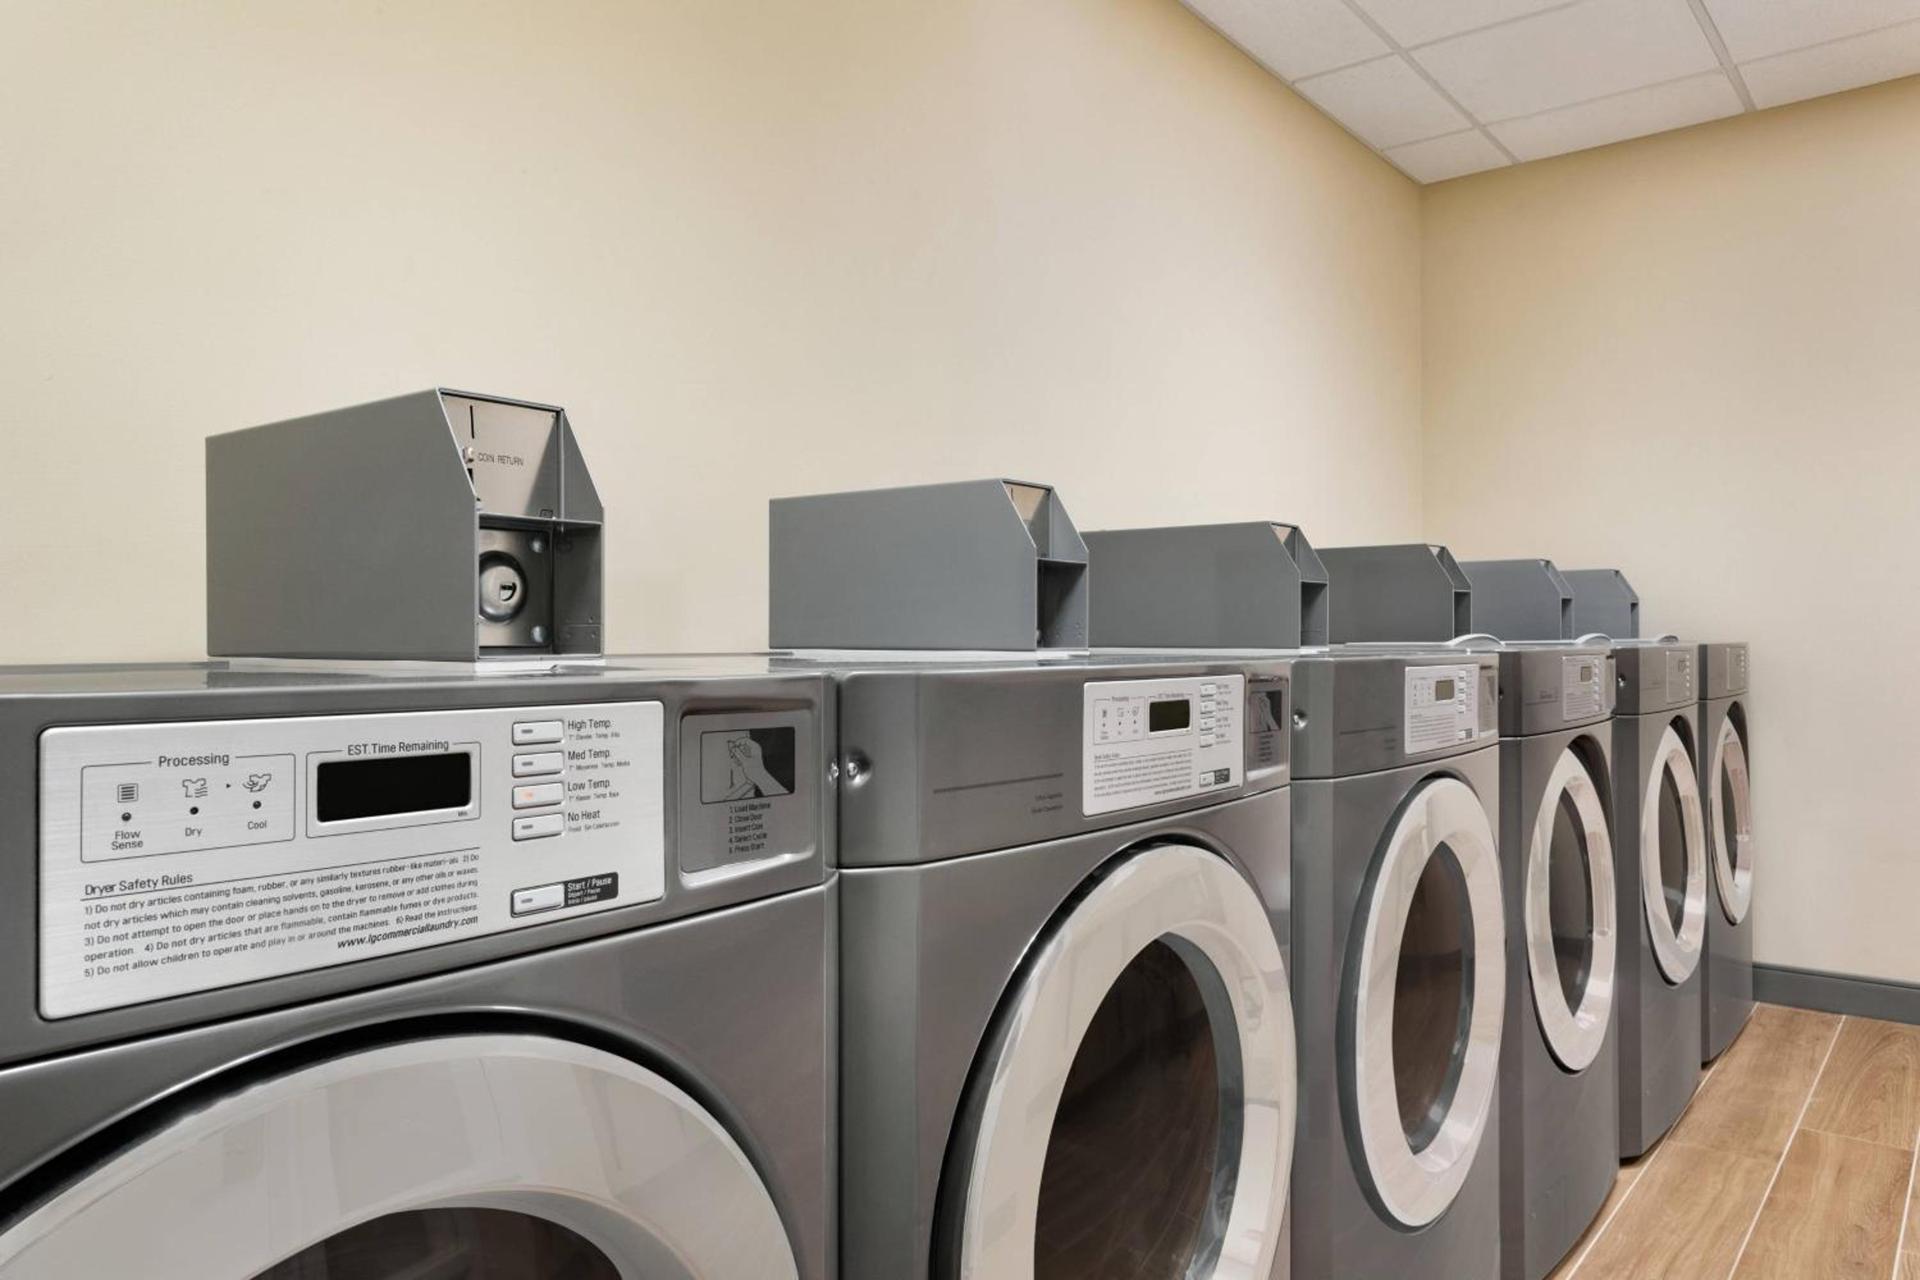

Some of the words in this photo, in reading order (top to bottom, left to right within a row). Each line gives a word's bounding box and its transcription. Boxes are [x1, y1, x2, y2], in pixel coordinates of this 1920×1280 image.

[478, 452, 494, 464] COIN
[498, 455, 524, 467] RETURN
[568, 720, 586, 731] High
[399, 740, 449, 752] Remaining
[158, 753, 230, 768] Processing
[568, 750, 585, 760] Med
[568, 781, 585, 792] Low
[568, 812, 579, 822] No
[581, 810, 600, 819] Heat
[185, 827, 203, 837] Dry
[247, 820, 267, 830] Cool
[114, 830, 141, 840] Flow
[112, 839, 143, 851] Sense
[85, 884, 116, 896] Dryer
[119, 878, 158, 891] Safety
[161, 874, 193, 886] Rules
[567, 881, 586, 891] Start
[591, 877, 612, 887] Pause
[84, 921, 100, 930] not
[103, 919, 119, 928] dry
[122, 913, 158, 925] articles
[160, 908, 189, 920] which
[190, 907, 209, 915] may
[211, 901, 244, 912] contain
[245, 896, 280, 907] cleaning
[402, 877, 414, 885] any
[416, 874, 433, 882] other
[435, 871, 446, 879] oils
[85, 905, 92, 915] 1)
[95, 904, 108, 913] Do
[111, 902, 126, 911] not
[129, 900, 145, 909] dry
[147, 895, 182, 906] articles
[184, 888, 231, 901] containing
[317, 872, 349, 883] similarly
[84, 937, 94, 946] 3)
[97, 935, 110, 944] Do
[113, 932, 129, 941] not
[131, 926, 169, 939] attempt
[172, 925, 182, 933] to
[184, 921, 206, 932] open
[208, 919, 223, 927] the
[225, 915, 244, 925] door
[258, 910, 281, 920] place
[283, 905, 308, 915] hands
[322, 902, 330, 910] to
[332, 900, 345, 908] the
[347, 897, 366, 906] dryer
[379, 891, 405, 900] remove
[416, 886, 429, 895] add
[431, 883, 455, 892] clothes
[457, 879, 478, 888] during
[144, 943, 154, 952] 4)
[156, 941, 169, 950] Do
[171, 939, 187, 948] not
[189, 937, 205, 945] dry
[208, 930, 241, 942] articles
[244, 926, 262, 936] that
[264, 925, 279, 933] are
[328, 912, 357, 922] contain
[359, 905, 398, 916] flammable
[400, 901, 421, 910] fumes
[432, 897, 445, 906] dye
[337, 915, 478, 948] www.lgcommerciallaundry.com
[84, 968, 94, 977] 5)
[97, 966, 110, 975] Do
[113, 963, 129, 972] not
[132, 959, 158, 970] allow
[160, 952, 199, 964] children
[213, 944, 248, 956] operate
[250, 940, 266, 949] and
[268, 938, 286, 948] play
[308, 928, 336, 939] around
[338, 926, 351, 934] the
[405, 912, 422, 922] Read
